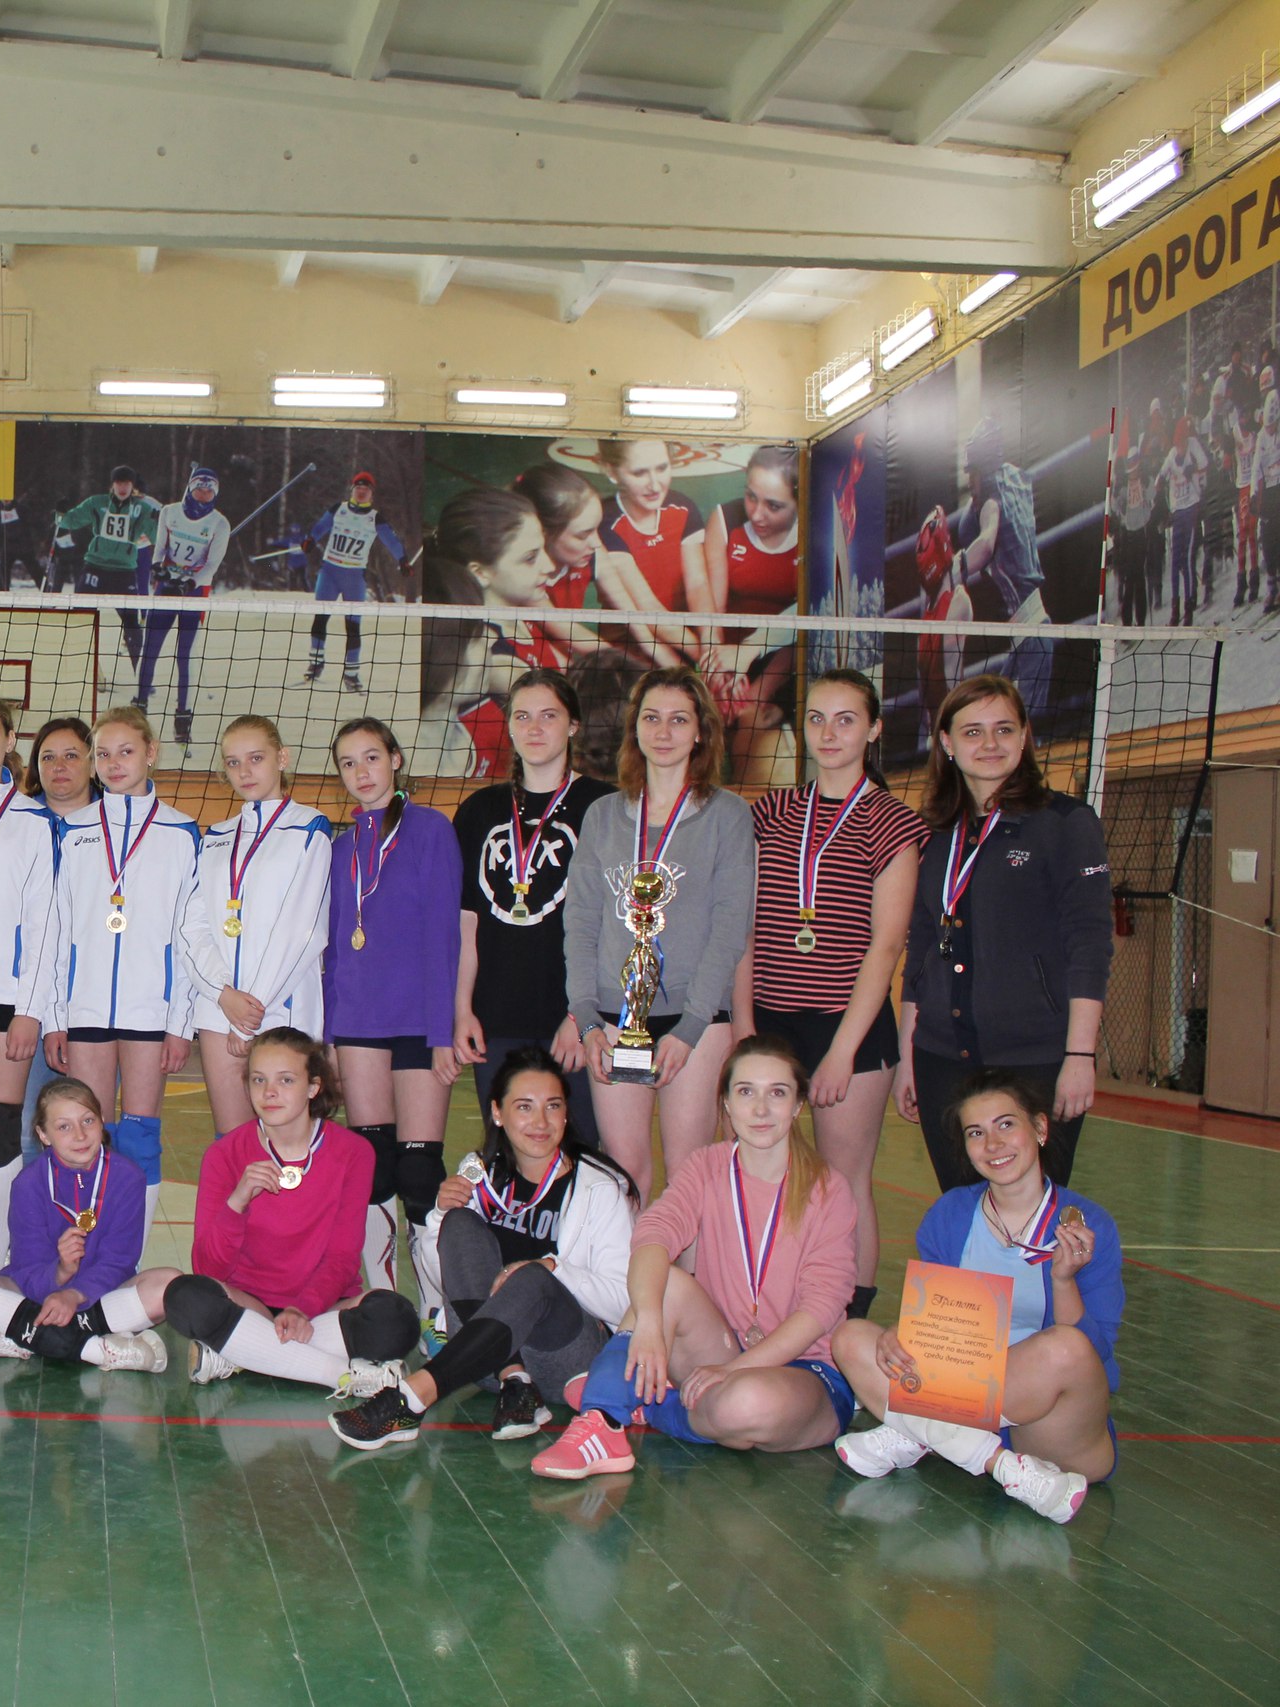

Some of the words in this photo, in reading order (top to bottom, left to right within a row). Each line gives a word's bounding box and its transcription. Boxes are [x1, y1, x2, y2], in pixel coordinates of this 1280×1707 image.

[106, 515, 126, 538] 63
[332, 533, 365, 556] 1072
[931, 1293, 982, 1312] Грамота
[910, 1319, 940, 1330] команда
[927, 1312, 980, 1327] Награждается
[914, 1340, 945, 1351] турнире
[956, 1348, 993, 1361] волейболу
[964, 1339, 988, 1349] место
[923, 1351, 944, 1361] среди
[945, 1354, 974, 1366] девушек
